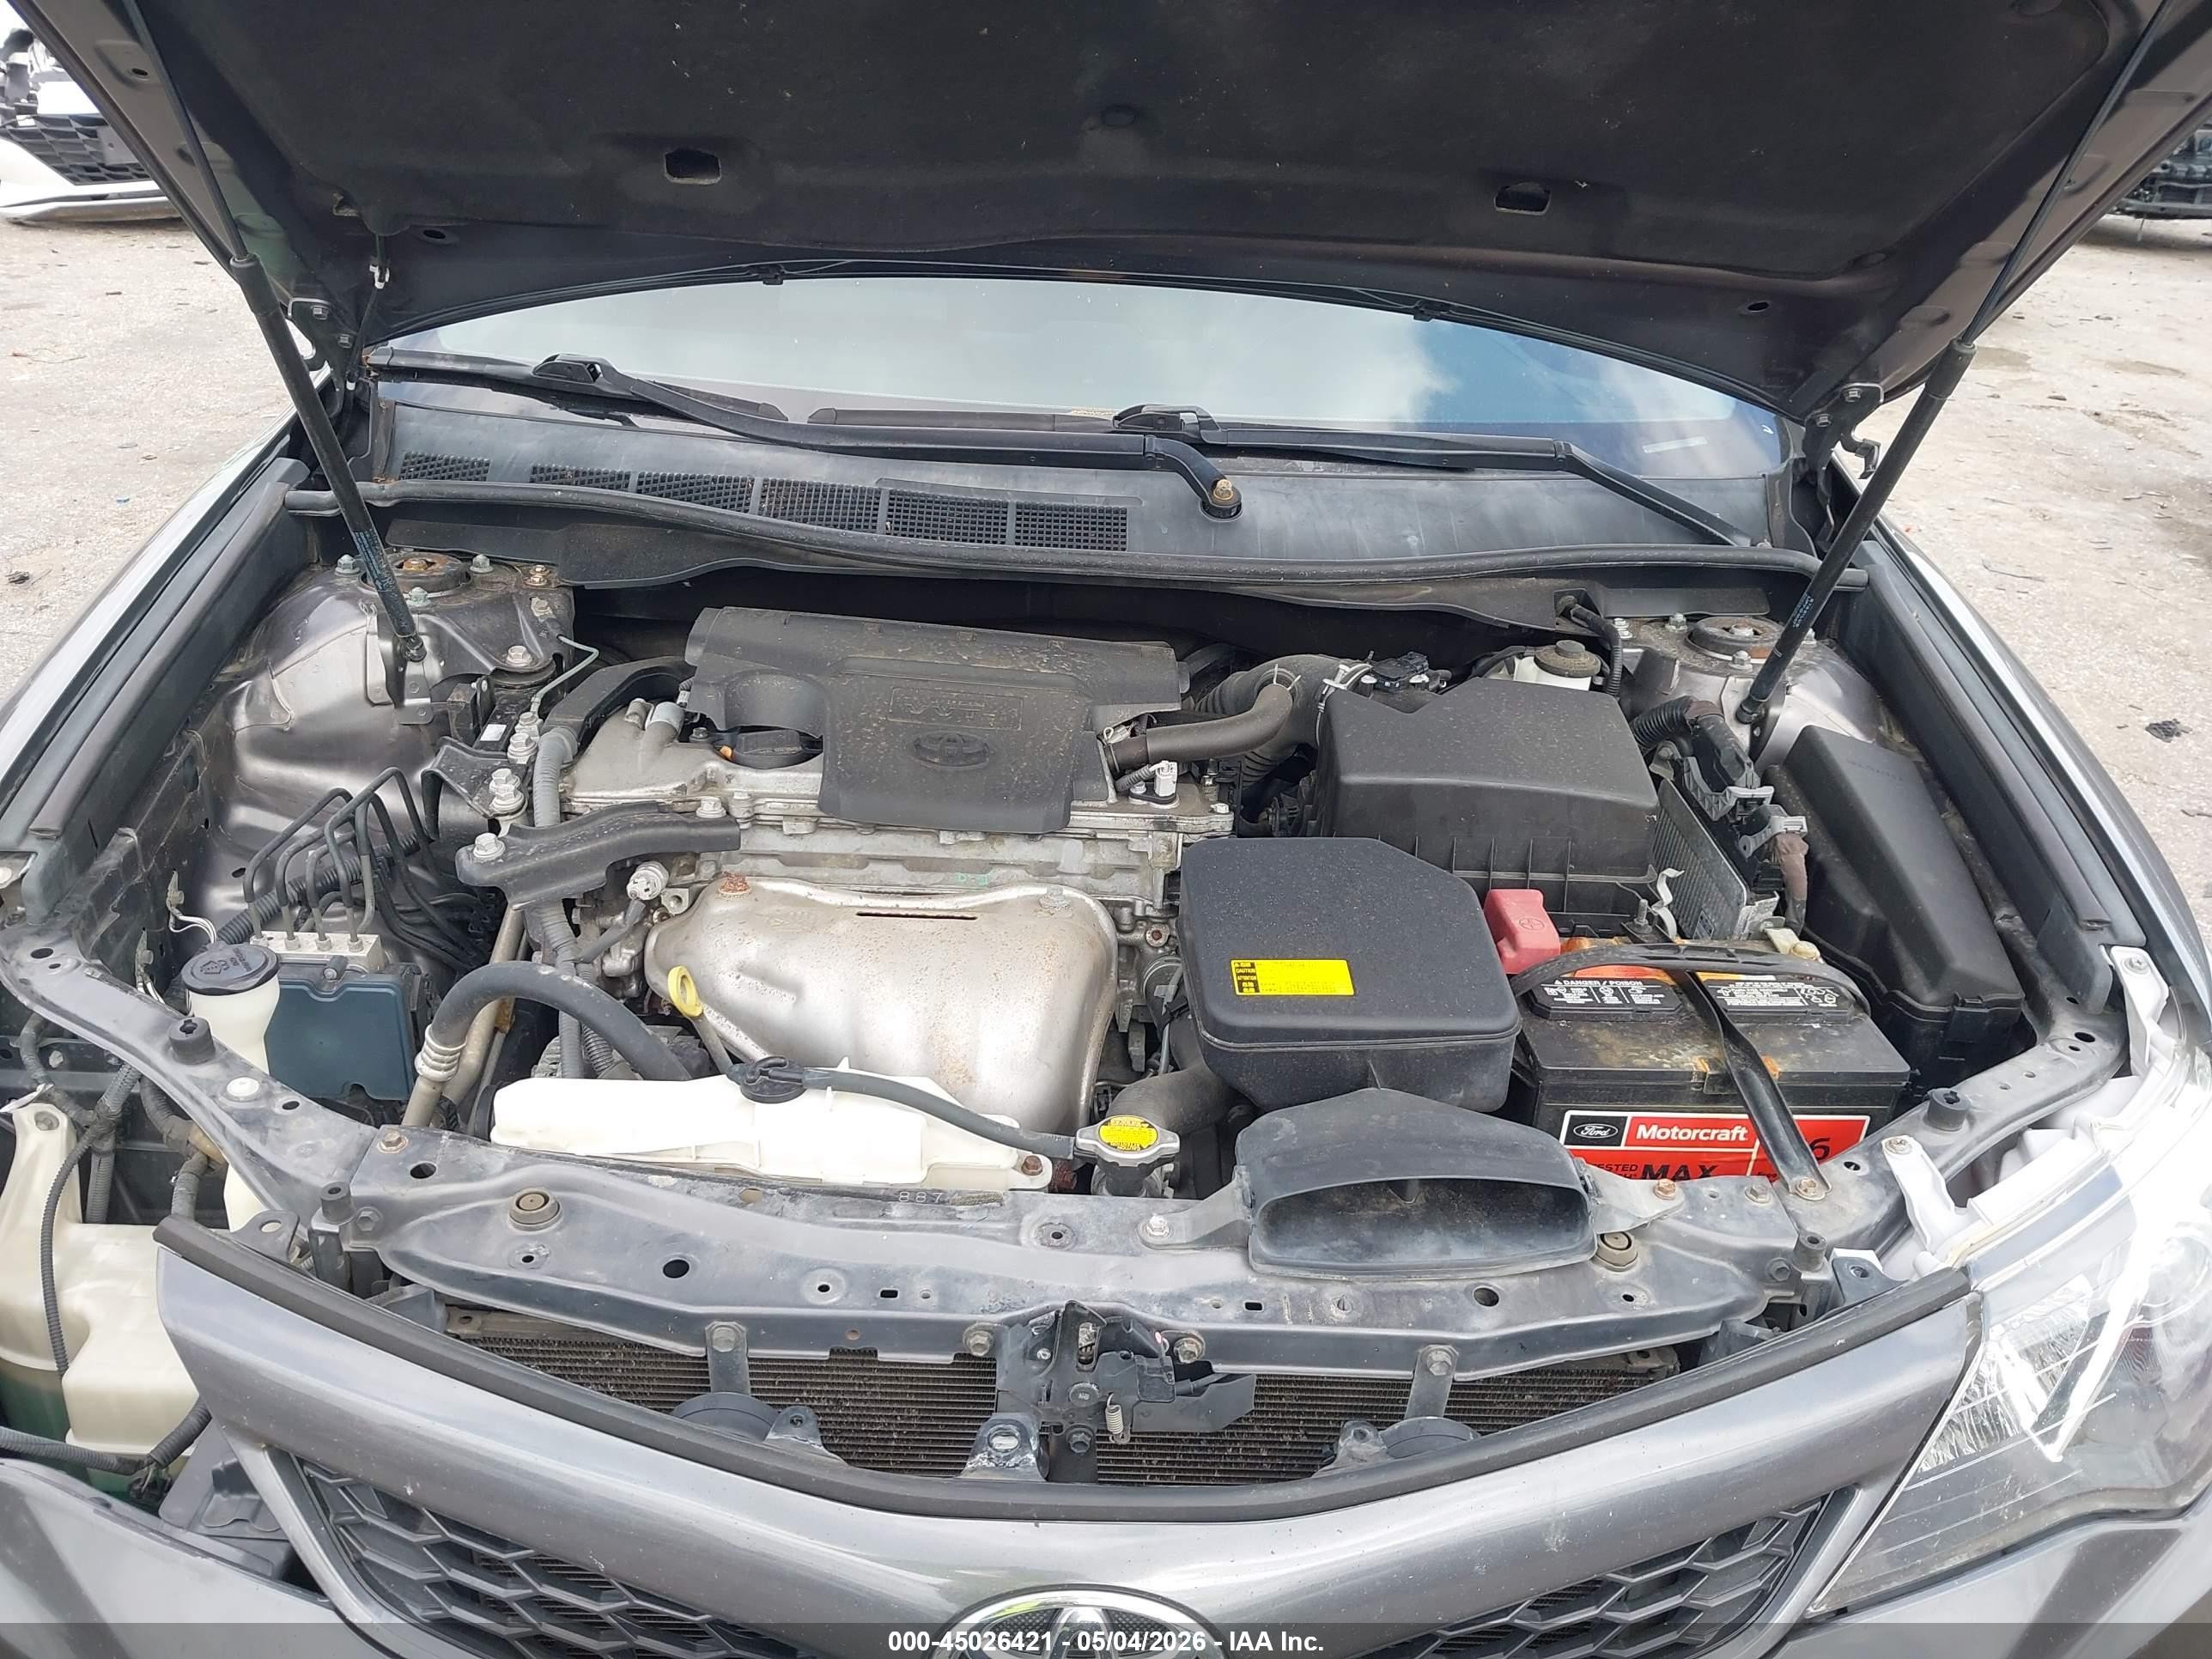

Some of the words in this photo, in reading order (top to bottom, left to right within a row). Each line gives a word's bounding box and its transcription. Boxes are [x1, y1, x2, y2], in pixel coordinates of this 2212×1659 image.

[1581, 1123, 1609, 1136] Ford
[1637, 1124, 1748, 1141] Motorcraft
[1591, 1164, 1638, 1172] ESTED
[1642, 1164, 1717, 1181] MAX
